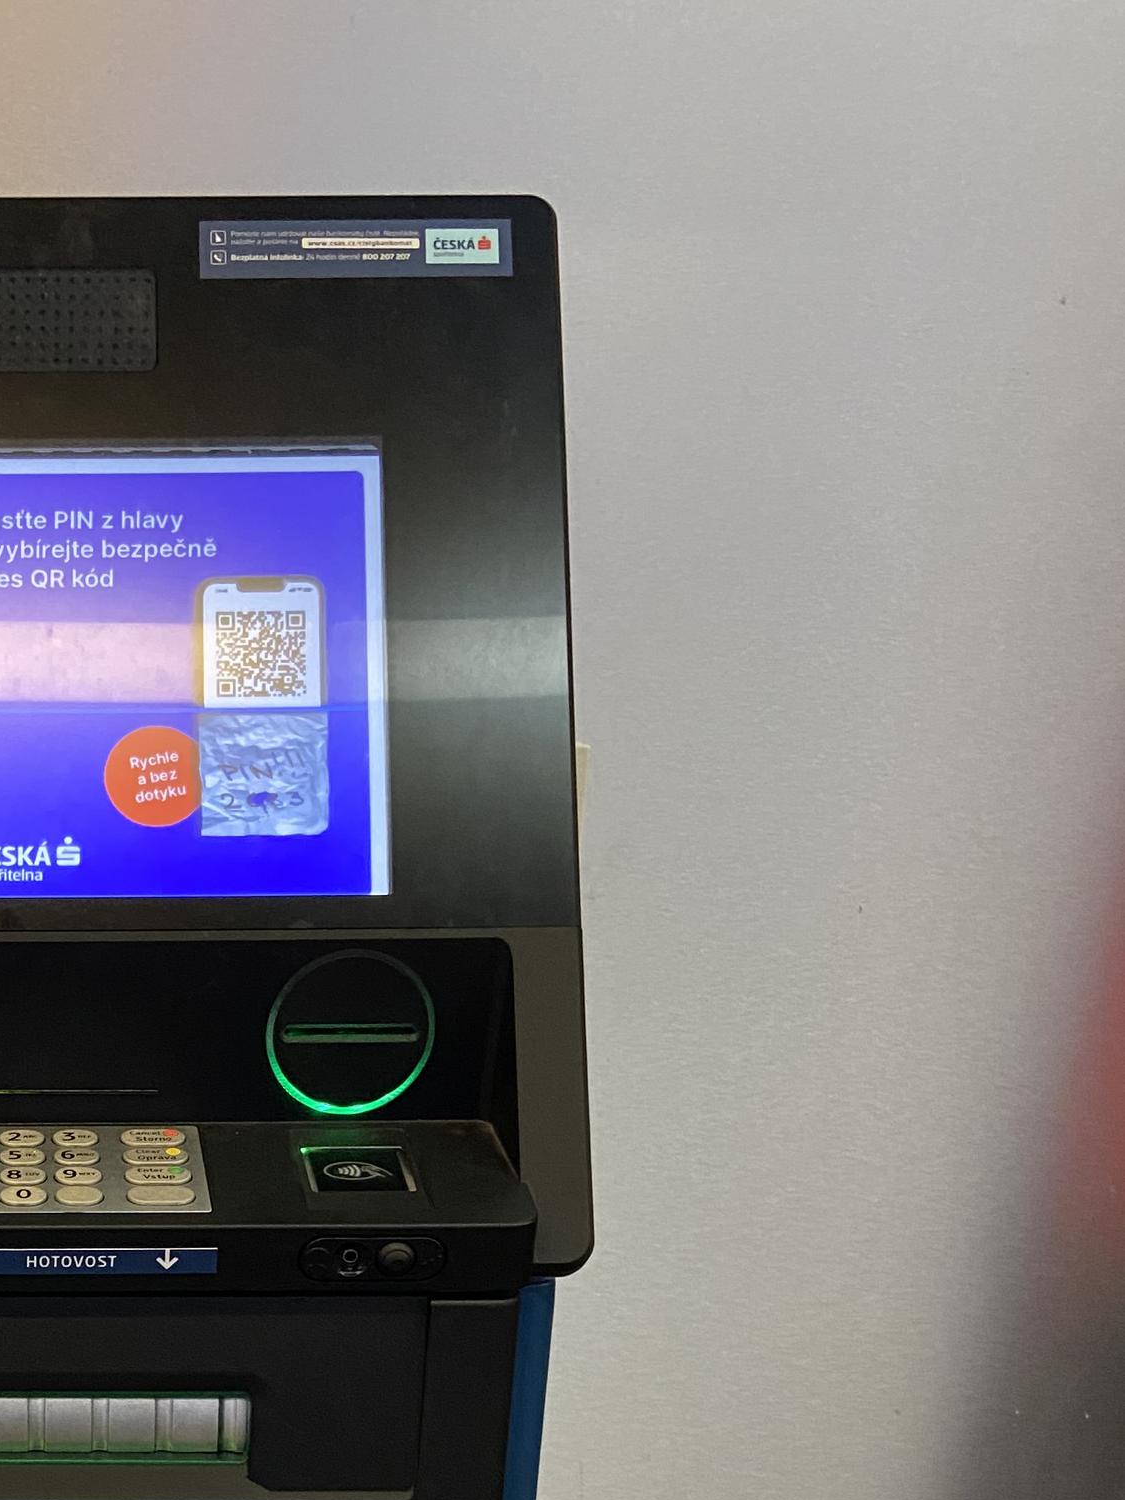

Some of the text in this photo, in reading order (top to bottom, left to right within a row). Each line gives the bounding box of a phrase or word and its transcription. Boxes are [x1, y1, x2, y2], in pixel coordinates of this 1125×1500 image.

[433, 236, 475, 250] ČESKÁ
[362, 253, 379, 261] 800
[379, 253, 395, 261] 207
[395, 253, 411, 261] 207
[53, 510, 94, 530] PIN
[101, 514, 114, 530] z
[121, 510, 184, 533] hlavy
[101, 537, 218, 563] bezpečně
[31, 569, 65, 589] QR
[72, 568, 115, 588] kód
[128, 751, 180, 772] Rychle
[137, 769, 178, 786] a bez
[134, 783, 187, 804] dotyku
[8, 1132, 22, 1142] 2
[62, 1132, 76, 1142] 3
[8, 1150, 22, 1160] 5
[61, 1150, 76, 1160] 6
[6, 1169, 22, 1180] 8
[62, 1169, 77, 1178] 9
[16, 1189, 32, 1199] 0
[25, 1255, 118, 1268] HOTOVOST
